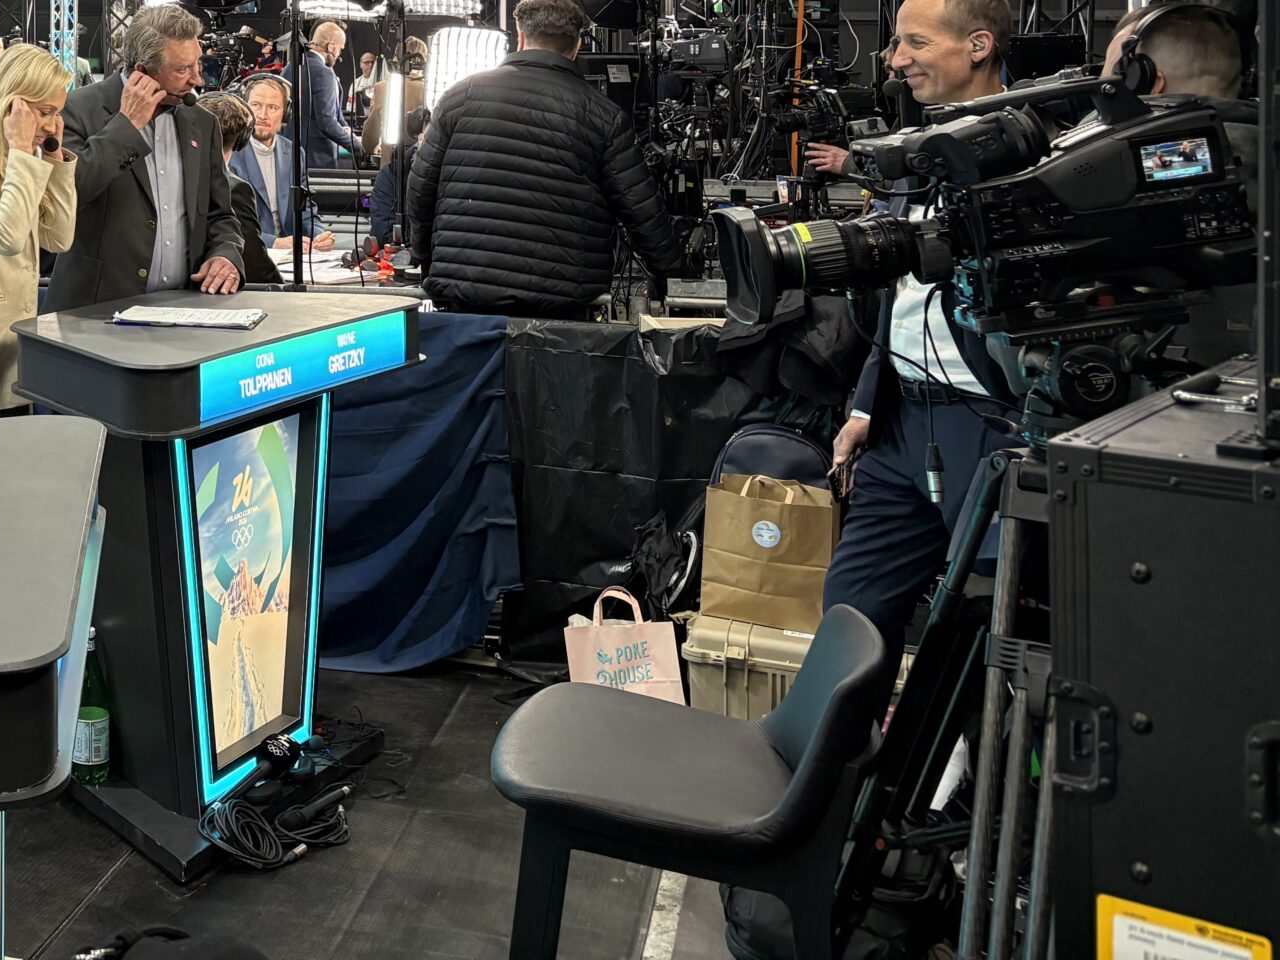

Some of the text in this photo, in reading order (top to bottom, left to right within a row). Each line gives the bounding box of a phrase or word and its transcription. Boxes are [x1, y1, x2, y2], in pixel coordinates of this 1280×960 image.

[256, 351, 275, 368] OONA
[328, 347, 366, 374] GRETZKY
[239, 367, 292, 398] TOLPPANEN
[615, 640, 650, 665] POKE
[596, 662, 654, 689] HOUSE
